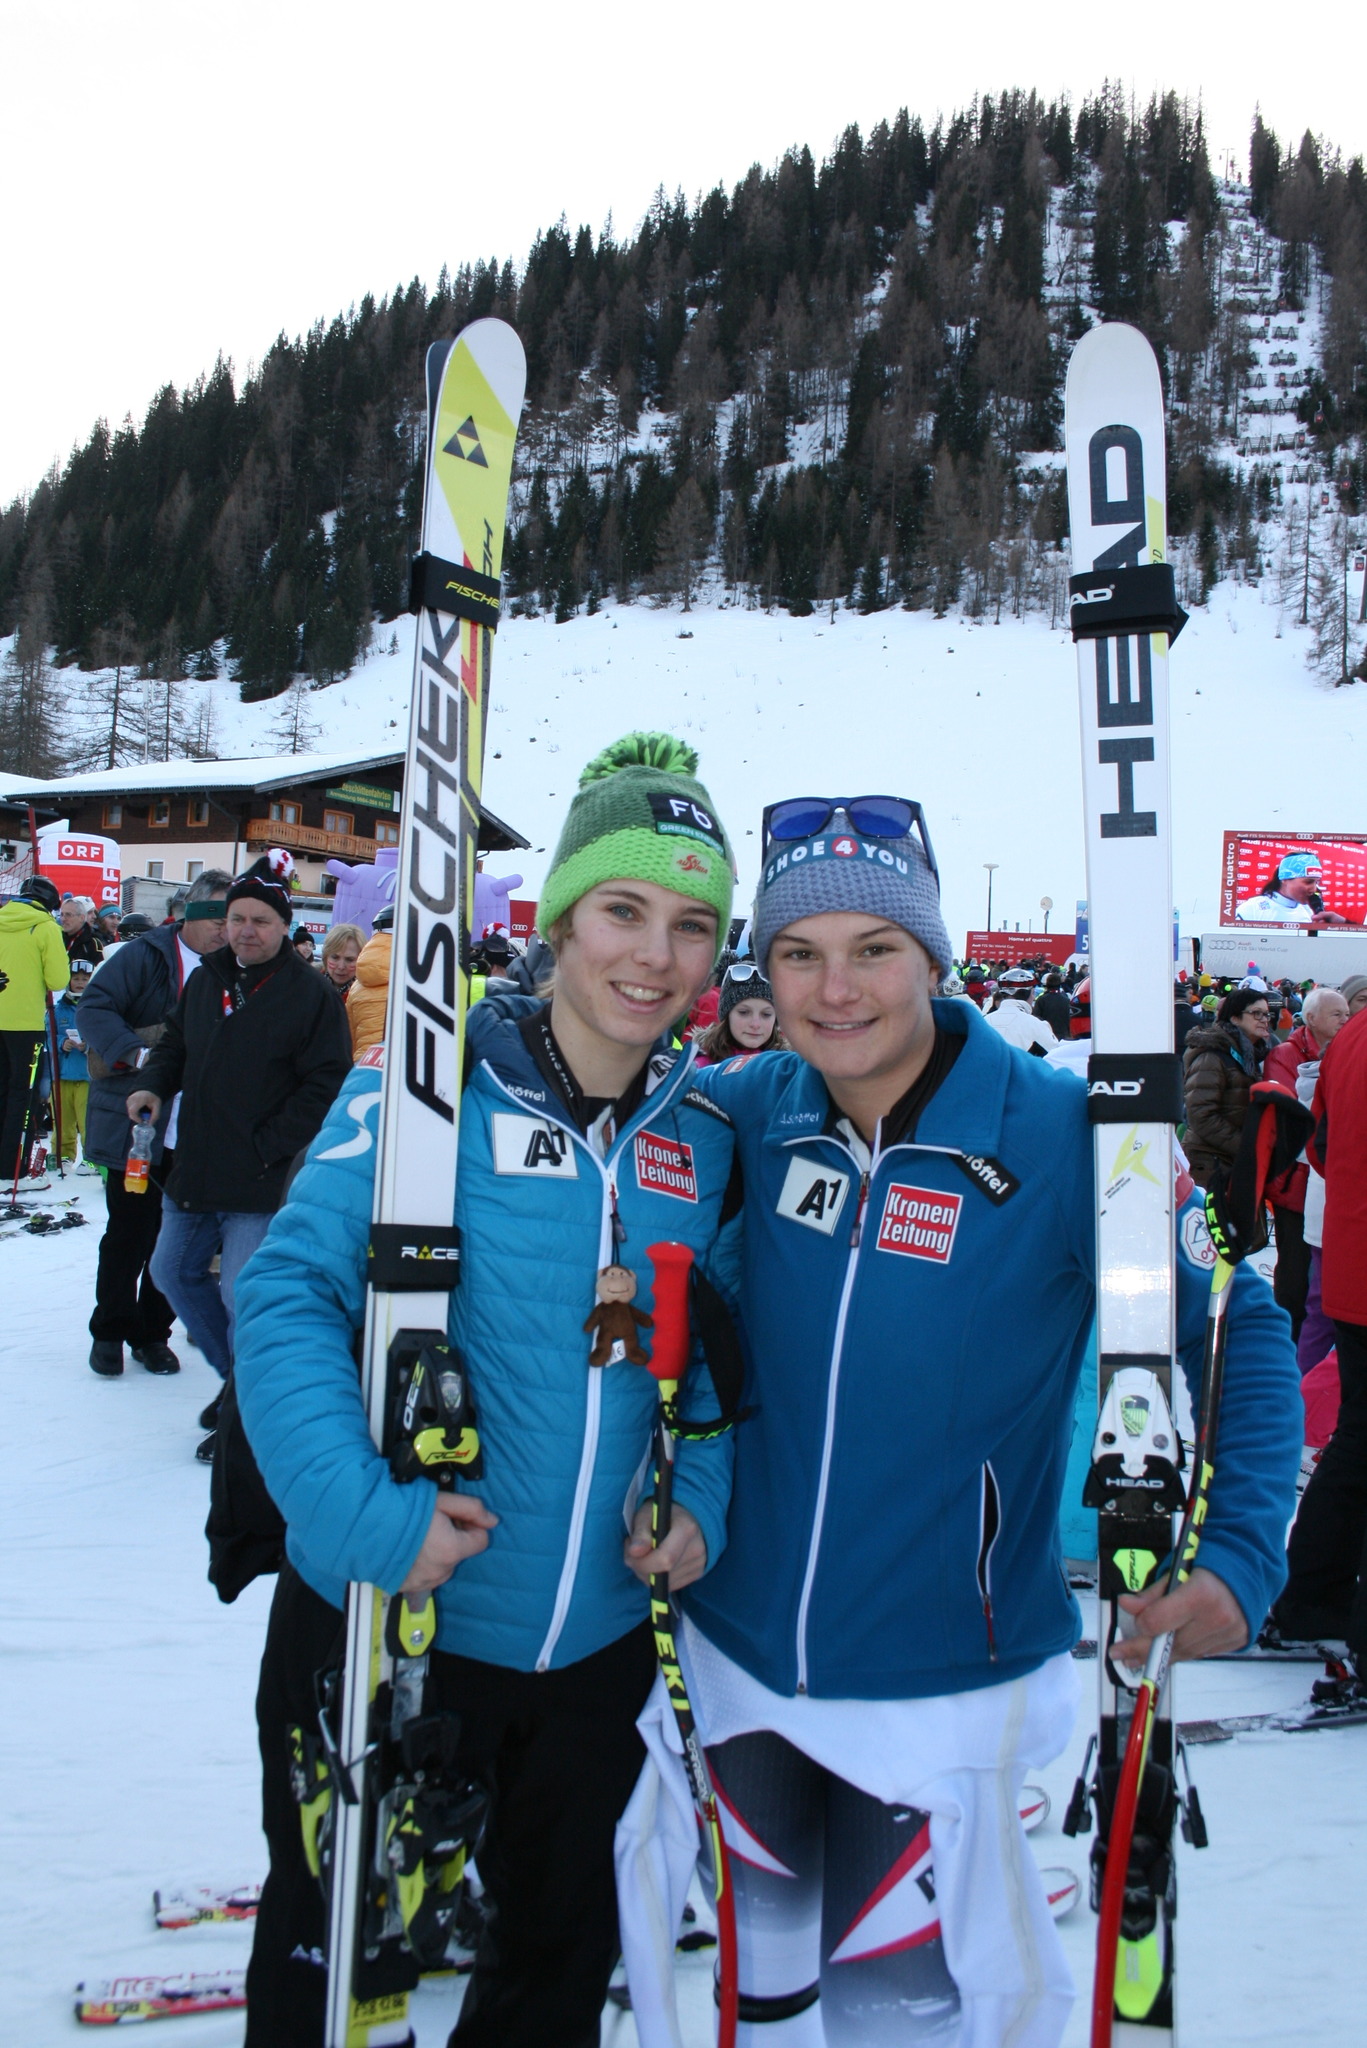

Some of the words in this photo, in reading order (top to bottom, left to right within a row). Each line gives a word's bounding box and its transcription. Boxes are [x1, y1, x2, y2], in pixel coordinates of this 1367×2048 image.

[62, 844, 101, 858] ORF
[767, 840, 825, 884] SHOE
[836, 840, 852, 854] 4
[862, 843, 908, 874] YOU
[1226, 842, 1235, 886] quattro
[1287, 844, 1305, 852] World
[1342, 845, 1365, 854] quattro
[1224, 890, 1232, 916] Audi
[524, 1128, 568, 1168] A1
[640, 1159, 694, 1194] Zeitung
[796, 1178, 843, 1220] A1
[887, 1192, 956, 1226] Kronen
[882, 1216, 950, 1254] Zeitung
[1206, 1192, 1230, 1255] LEKI
[1106, 1477, 1164, 1488] HEAD
[651, 1600, 690, 1711] LEKI
